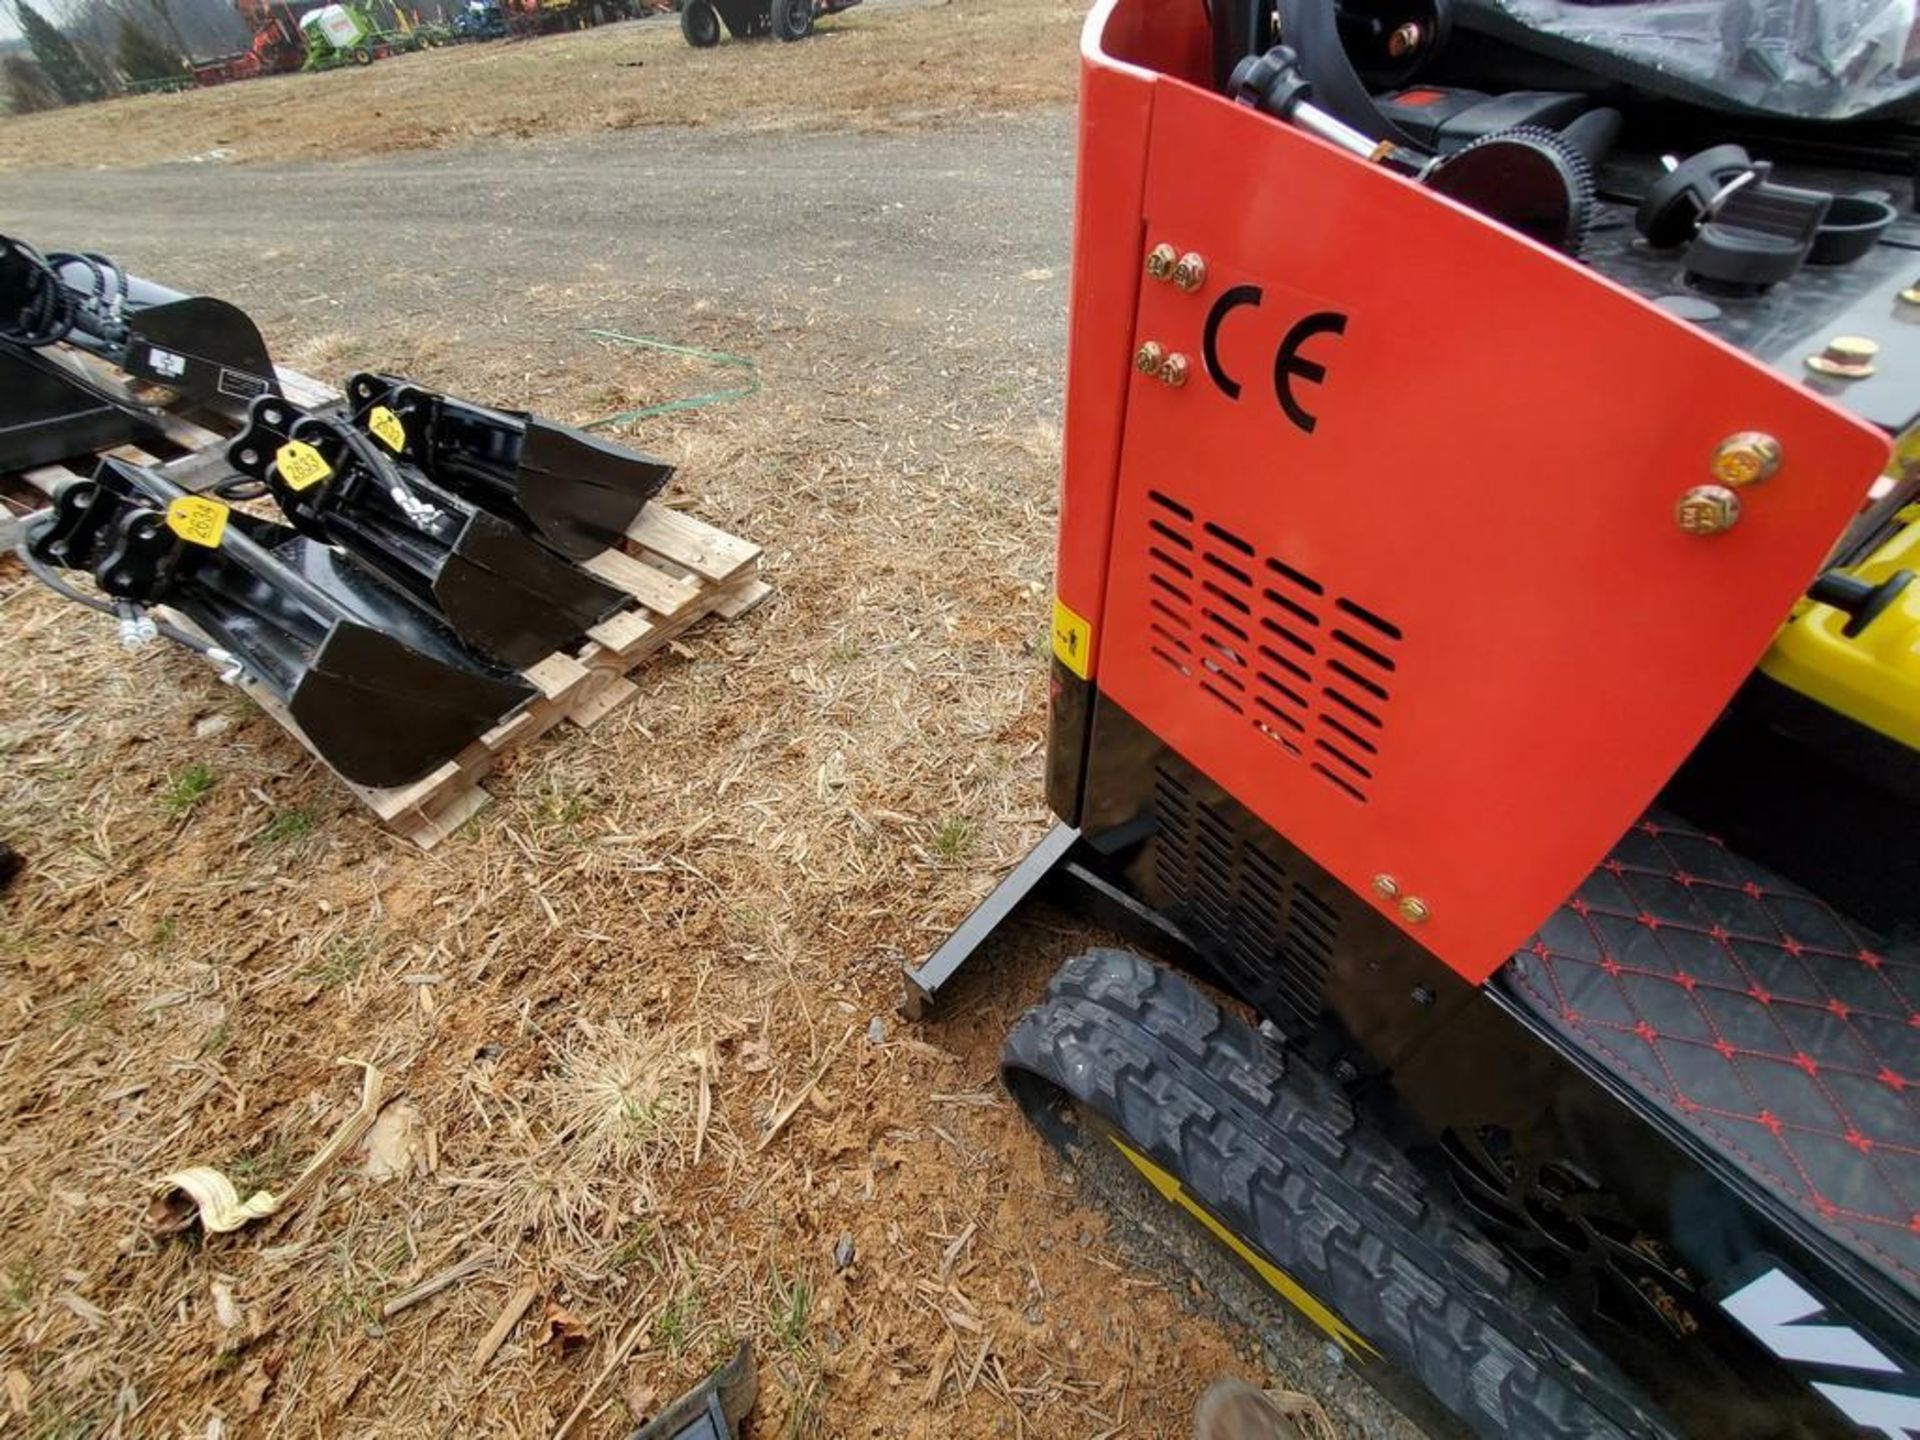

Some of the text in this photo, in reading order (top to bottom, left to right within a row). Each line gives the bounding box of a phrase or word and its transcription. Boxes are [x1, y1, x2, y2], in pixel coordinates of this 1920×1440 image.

[1203, 284, 1348, 434] CE
[286, 453, 320, 482] 2633
[186, 503, 215, 538] 2634
